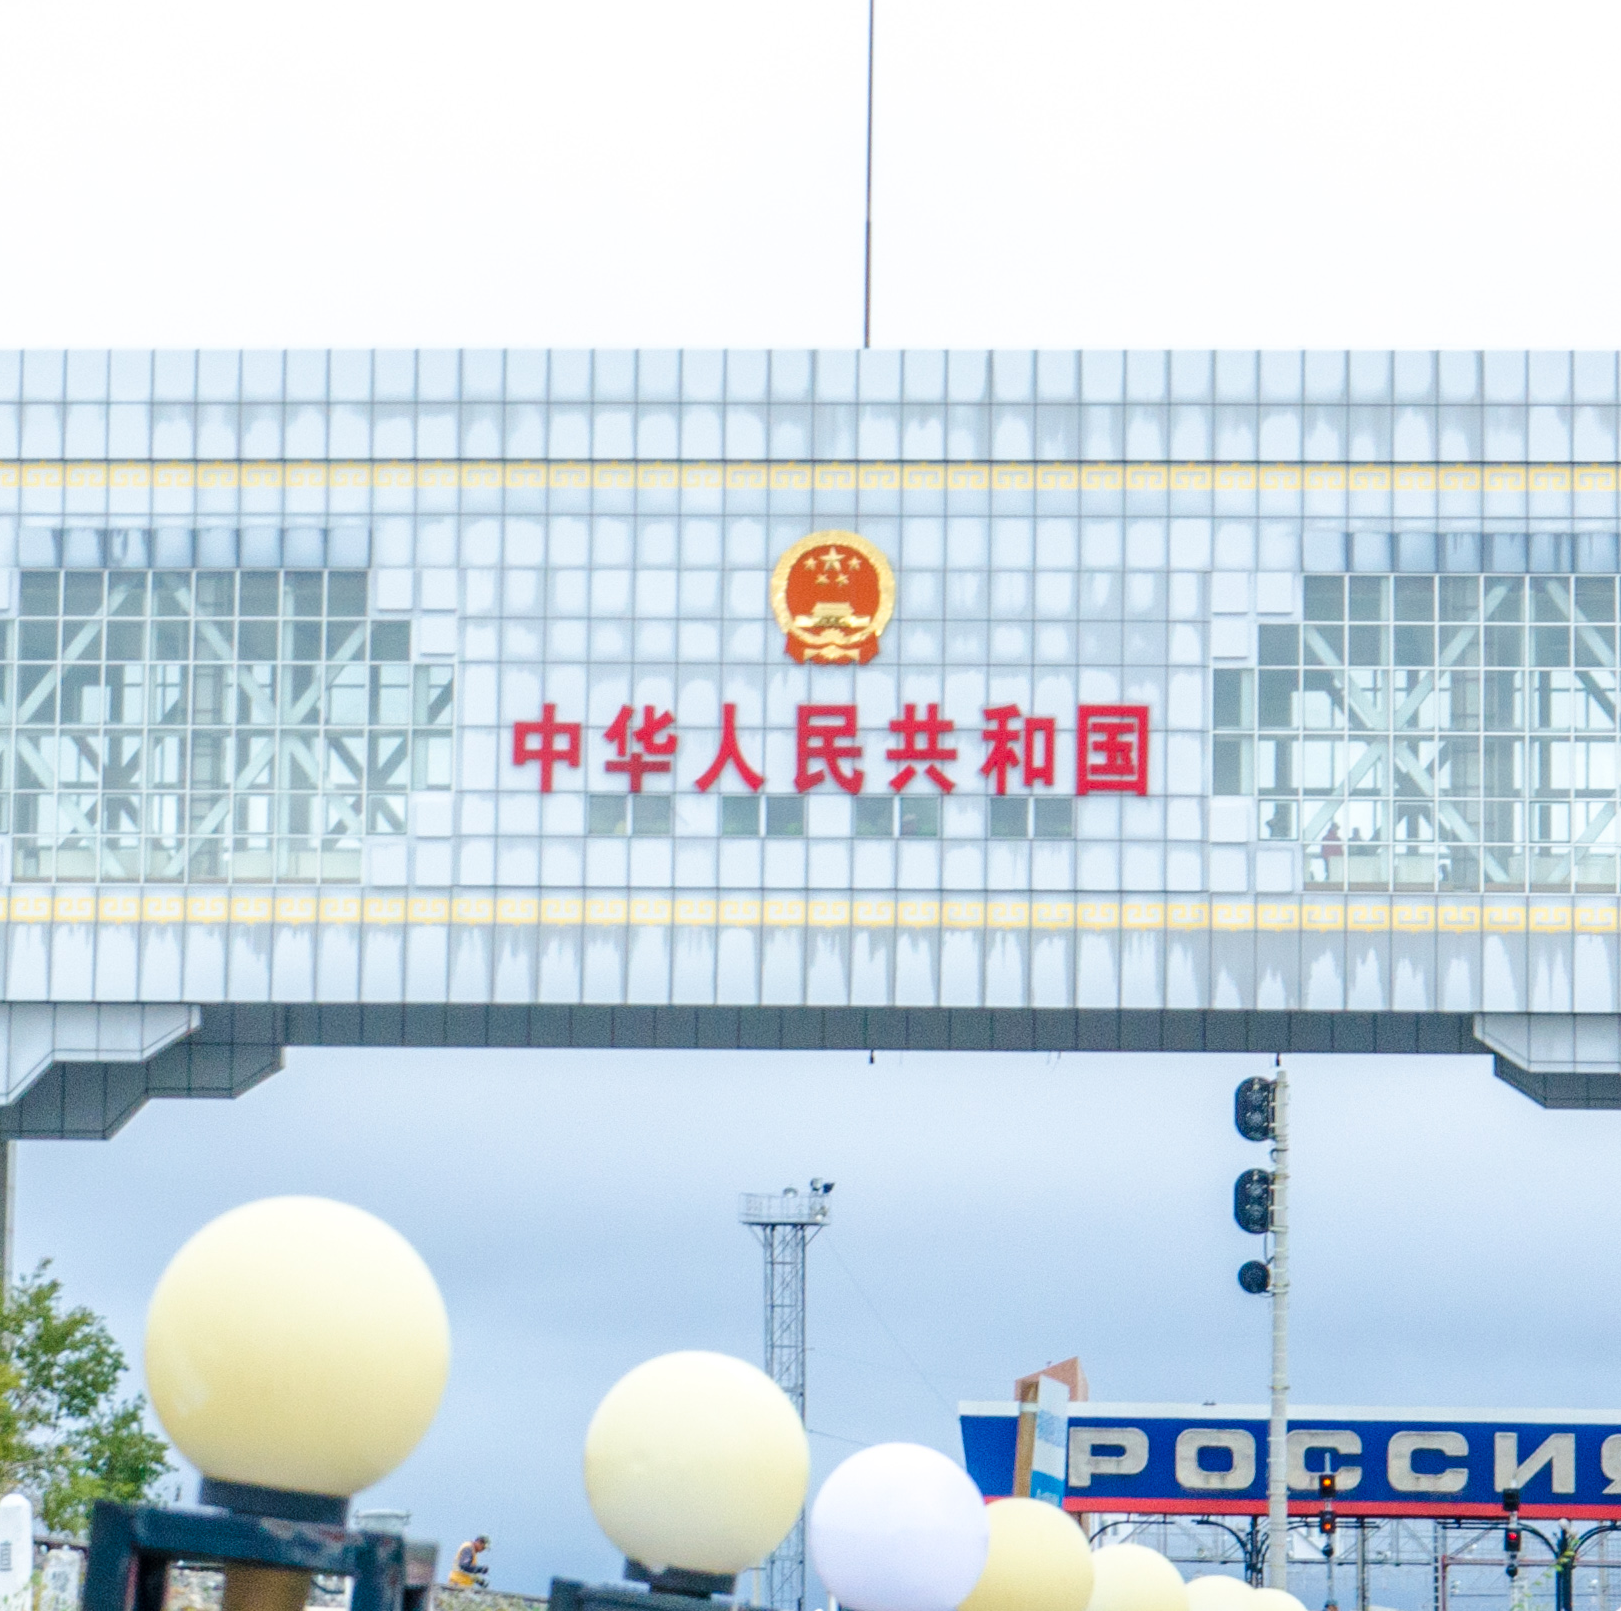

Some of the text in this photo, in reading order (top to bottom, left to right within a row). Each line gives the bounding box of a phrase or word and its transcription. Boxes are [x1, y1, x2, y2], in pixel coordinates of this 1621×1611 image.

[512, 702, 1149, 796] 中华人民共和国
